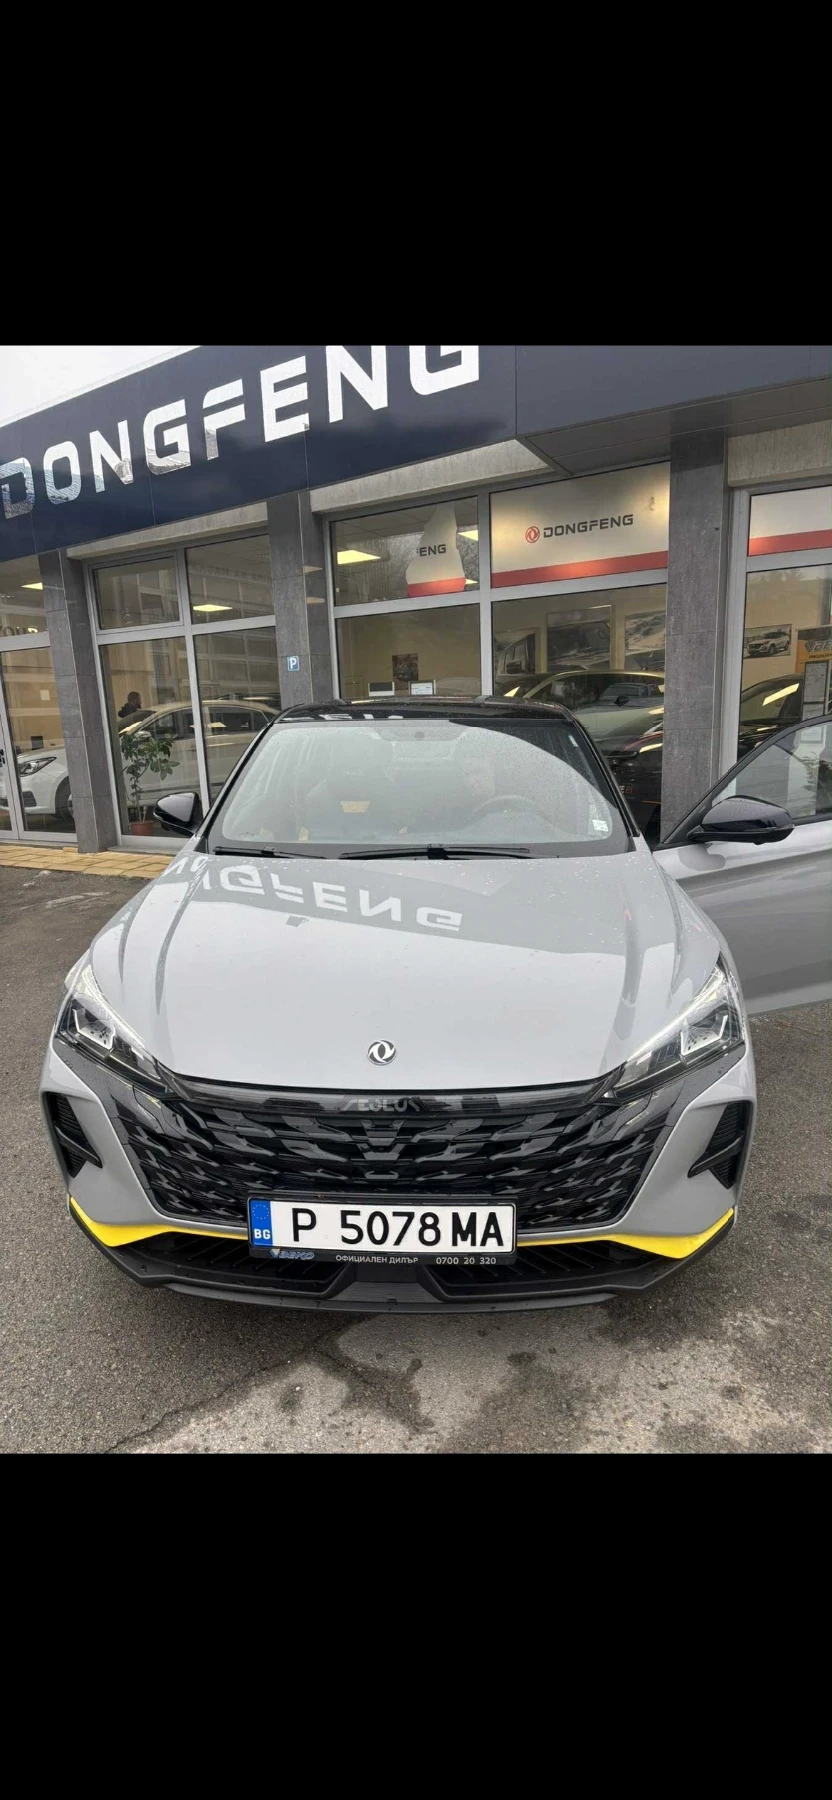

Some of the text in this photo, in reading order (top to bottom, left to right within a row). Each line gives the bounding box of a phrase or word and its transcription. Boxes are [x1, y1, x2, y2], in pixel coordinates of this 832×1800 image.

[0, 345, 480, 519] DONGFENG
[543, 514, 634, 538] DONGFENG
[254, 1228, 271, 1240] BG
[292, 1208, 504, 1247] P 5078 MA
[335, 1254, 419, 1265] ОФИЦИАЛЕН ДИЛЪР
[435, 1256, 497, 1265] 0700 20 320
